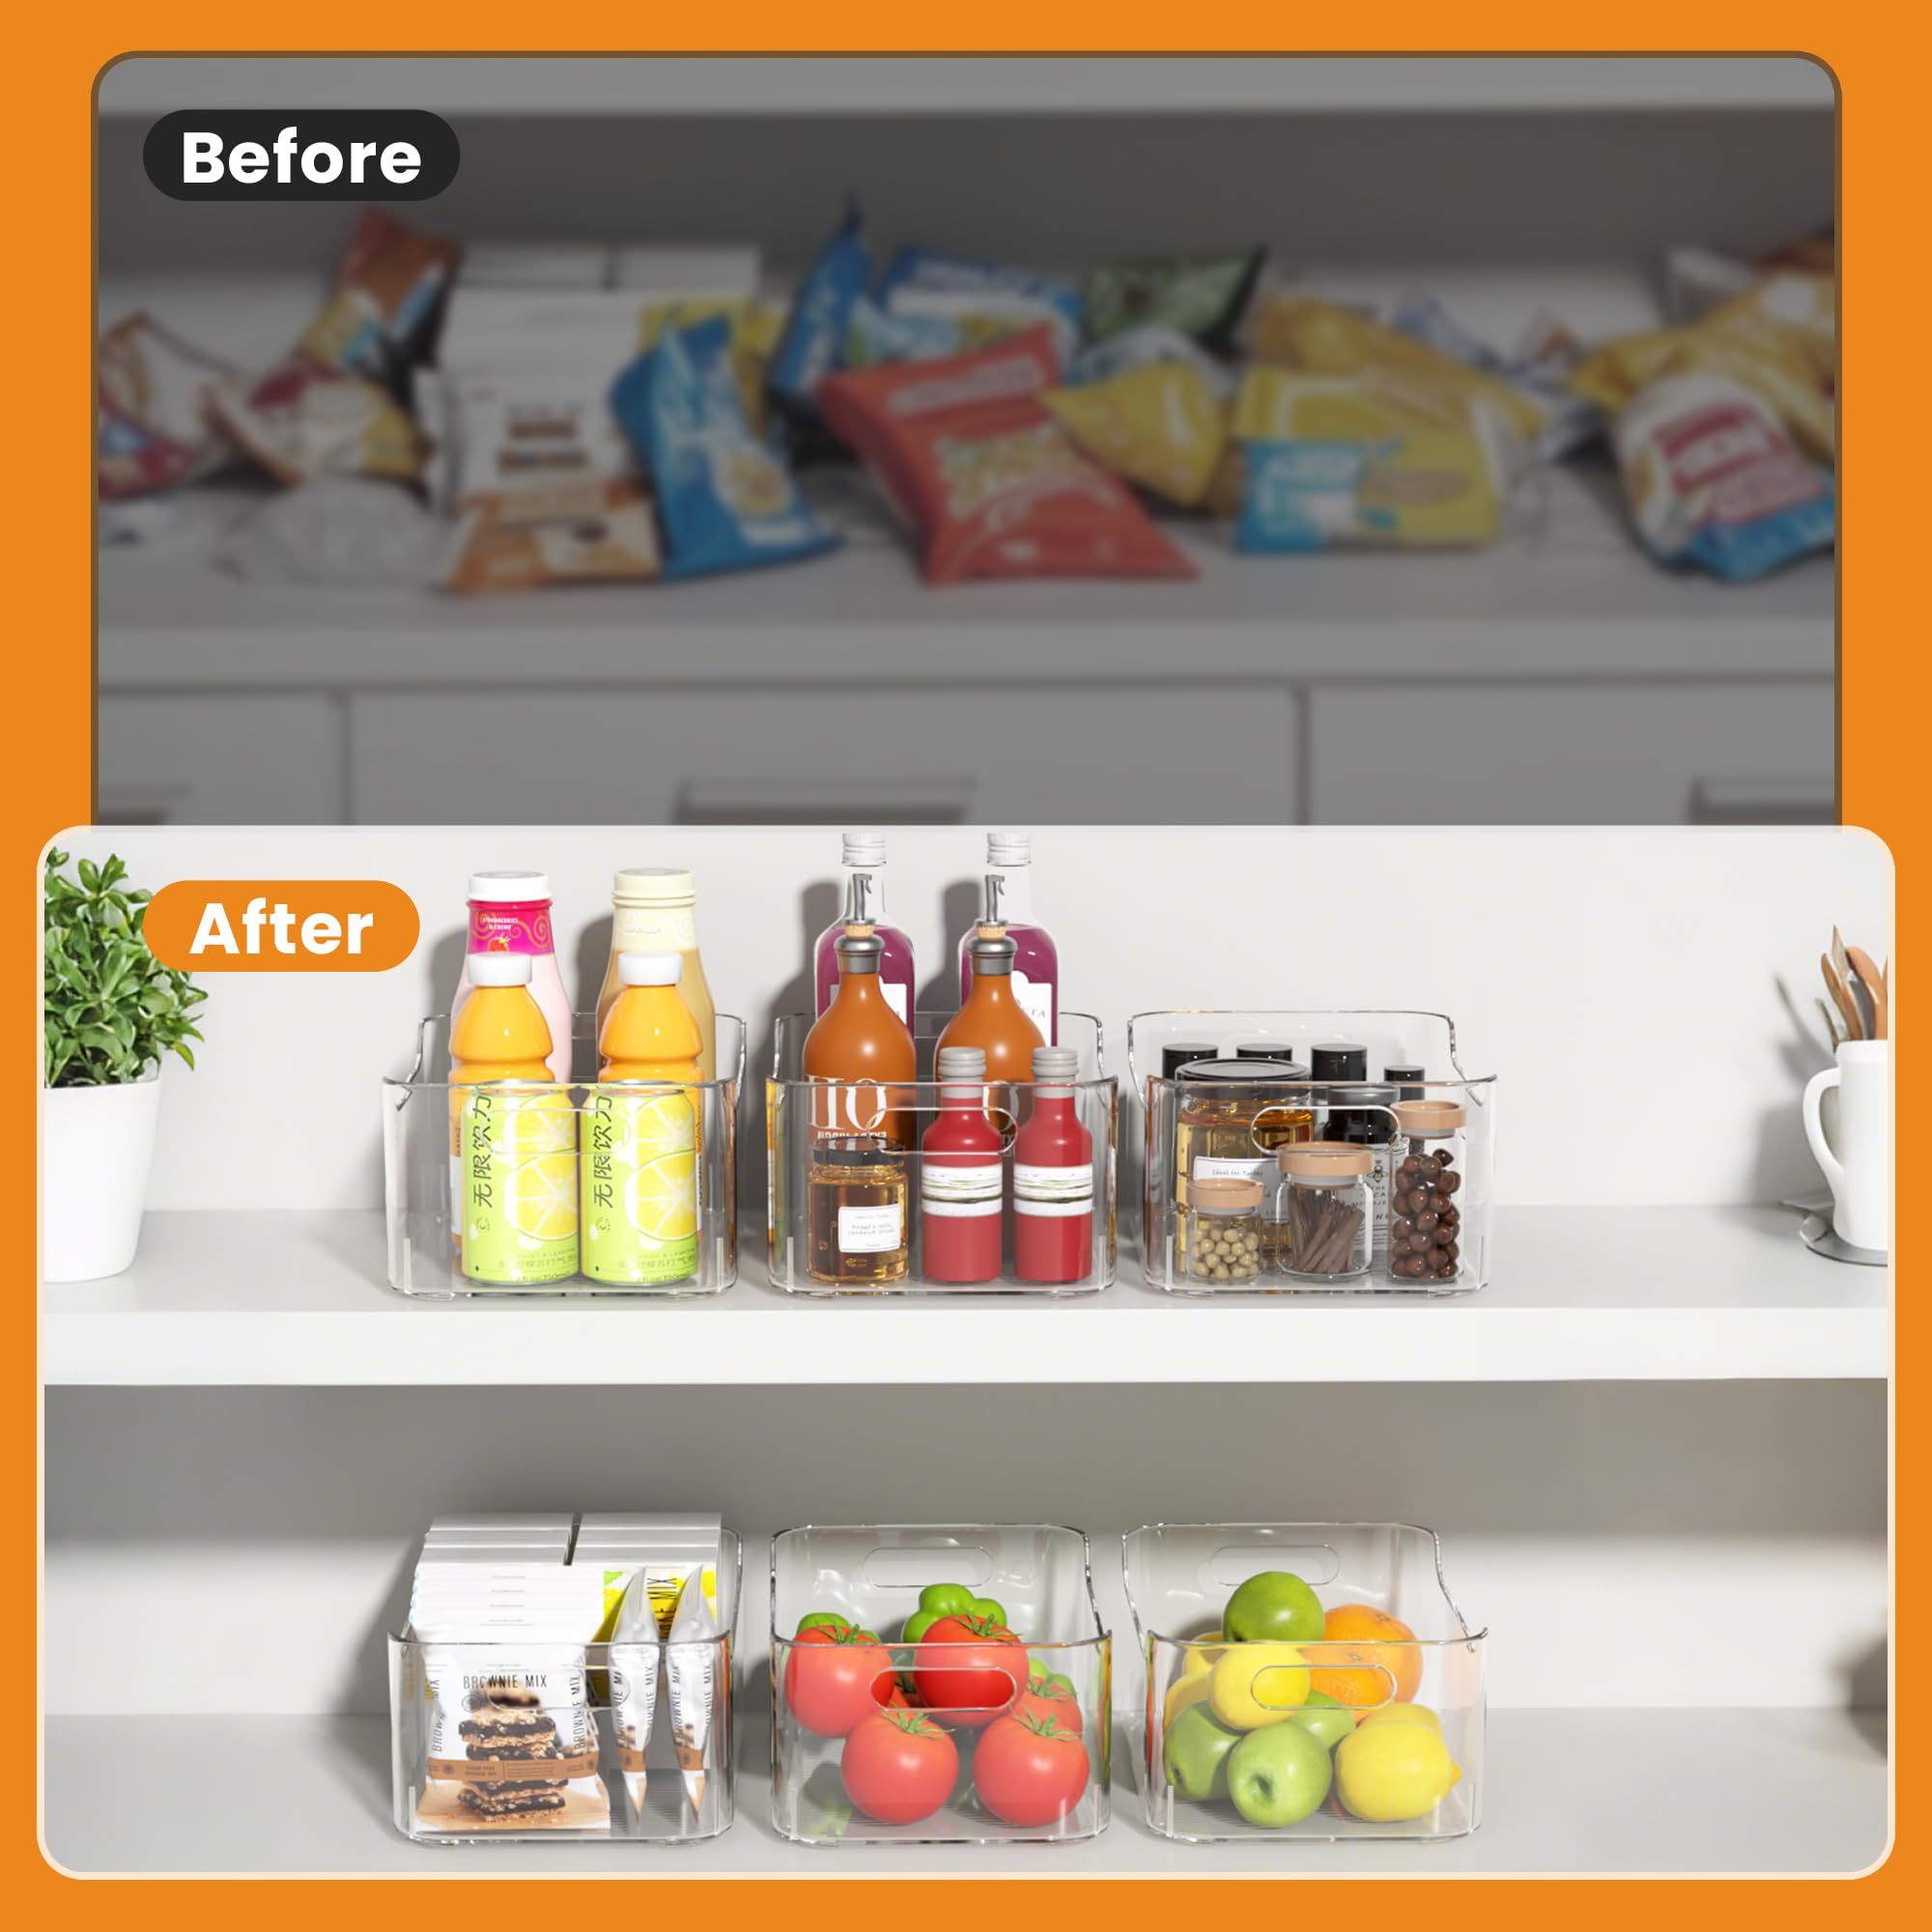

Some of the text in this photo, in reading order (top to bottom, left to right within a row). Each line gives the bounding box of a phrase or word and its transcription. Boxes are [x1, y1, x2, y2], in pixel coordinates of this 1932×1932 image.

[472, 1095, 493, 1208] 无限饮力
[646, 1577, 677, 1600] MIX
[464, 1674, 548, 1690] BROWNIE MIX
